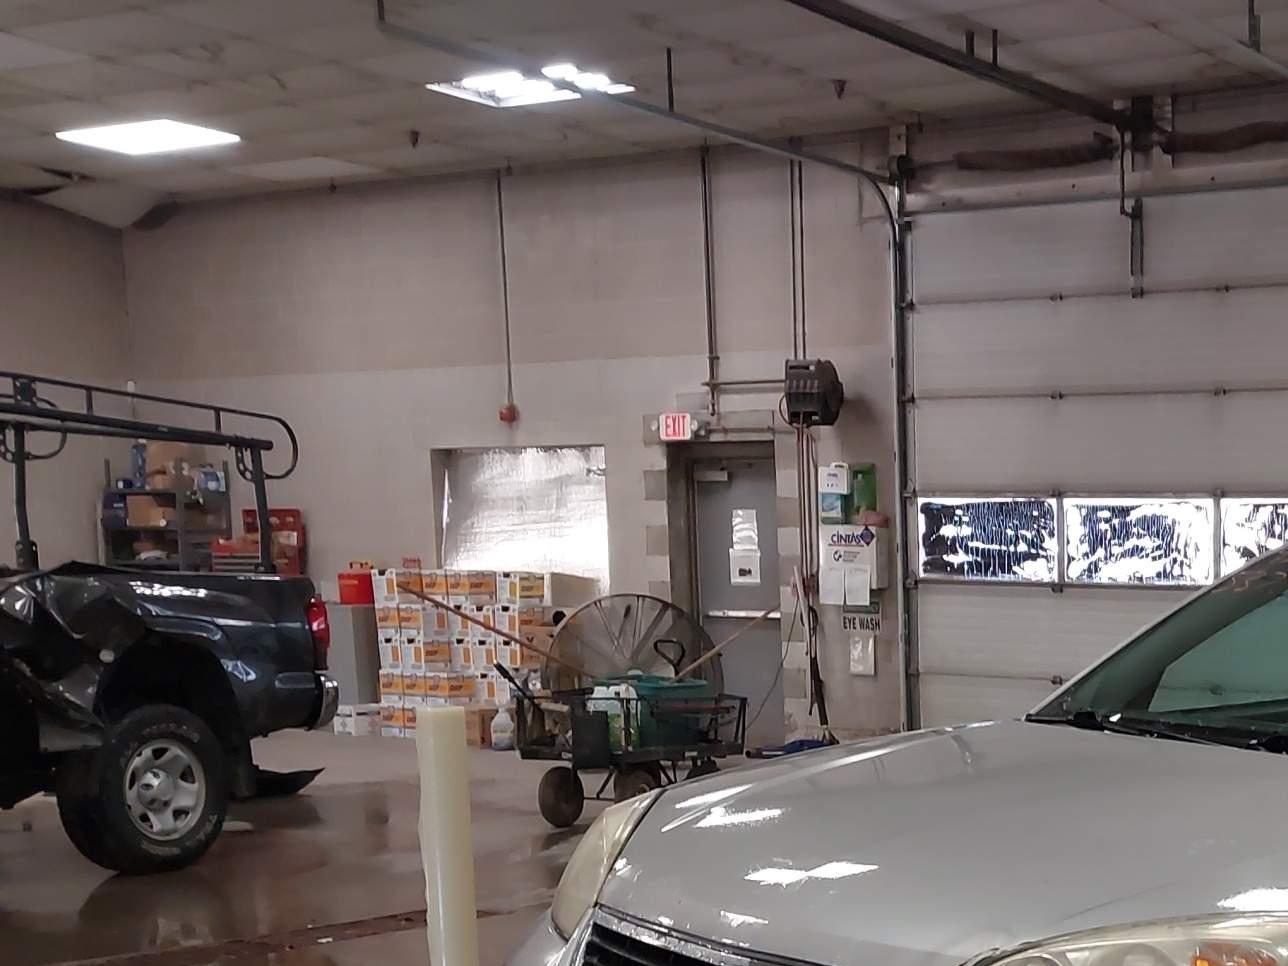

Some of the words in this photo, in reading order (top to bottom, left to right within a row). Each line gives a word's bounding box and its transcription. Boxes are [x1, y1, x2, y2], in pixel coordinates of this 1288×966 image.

[665, 415, 686, 437] EXIT
[831, 531, 861, 544] CINTAS
[843, 616, 856, 629] EYE
[859, 617, 880, 631] WASH
